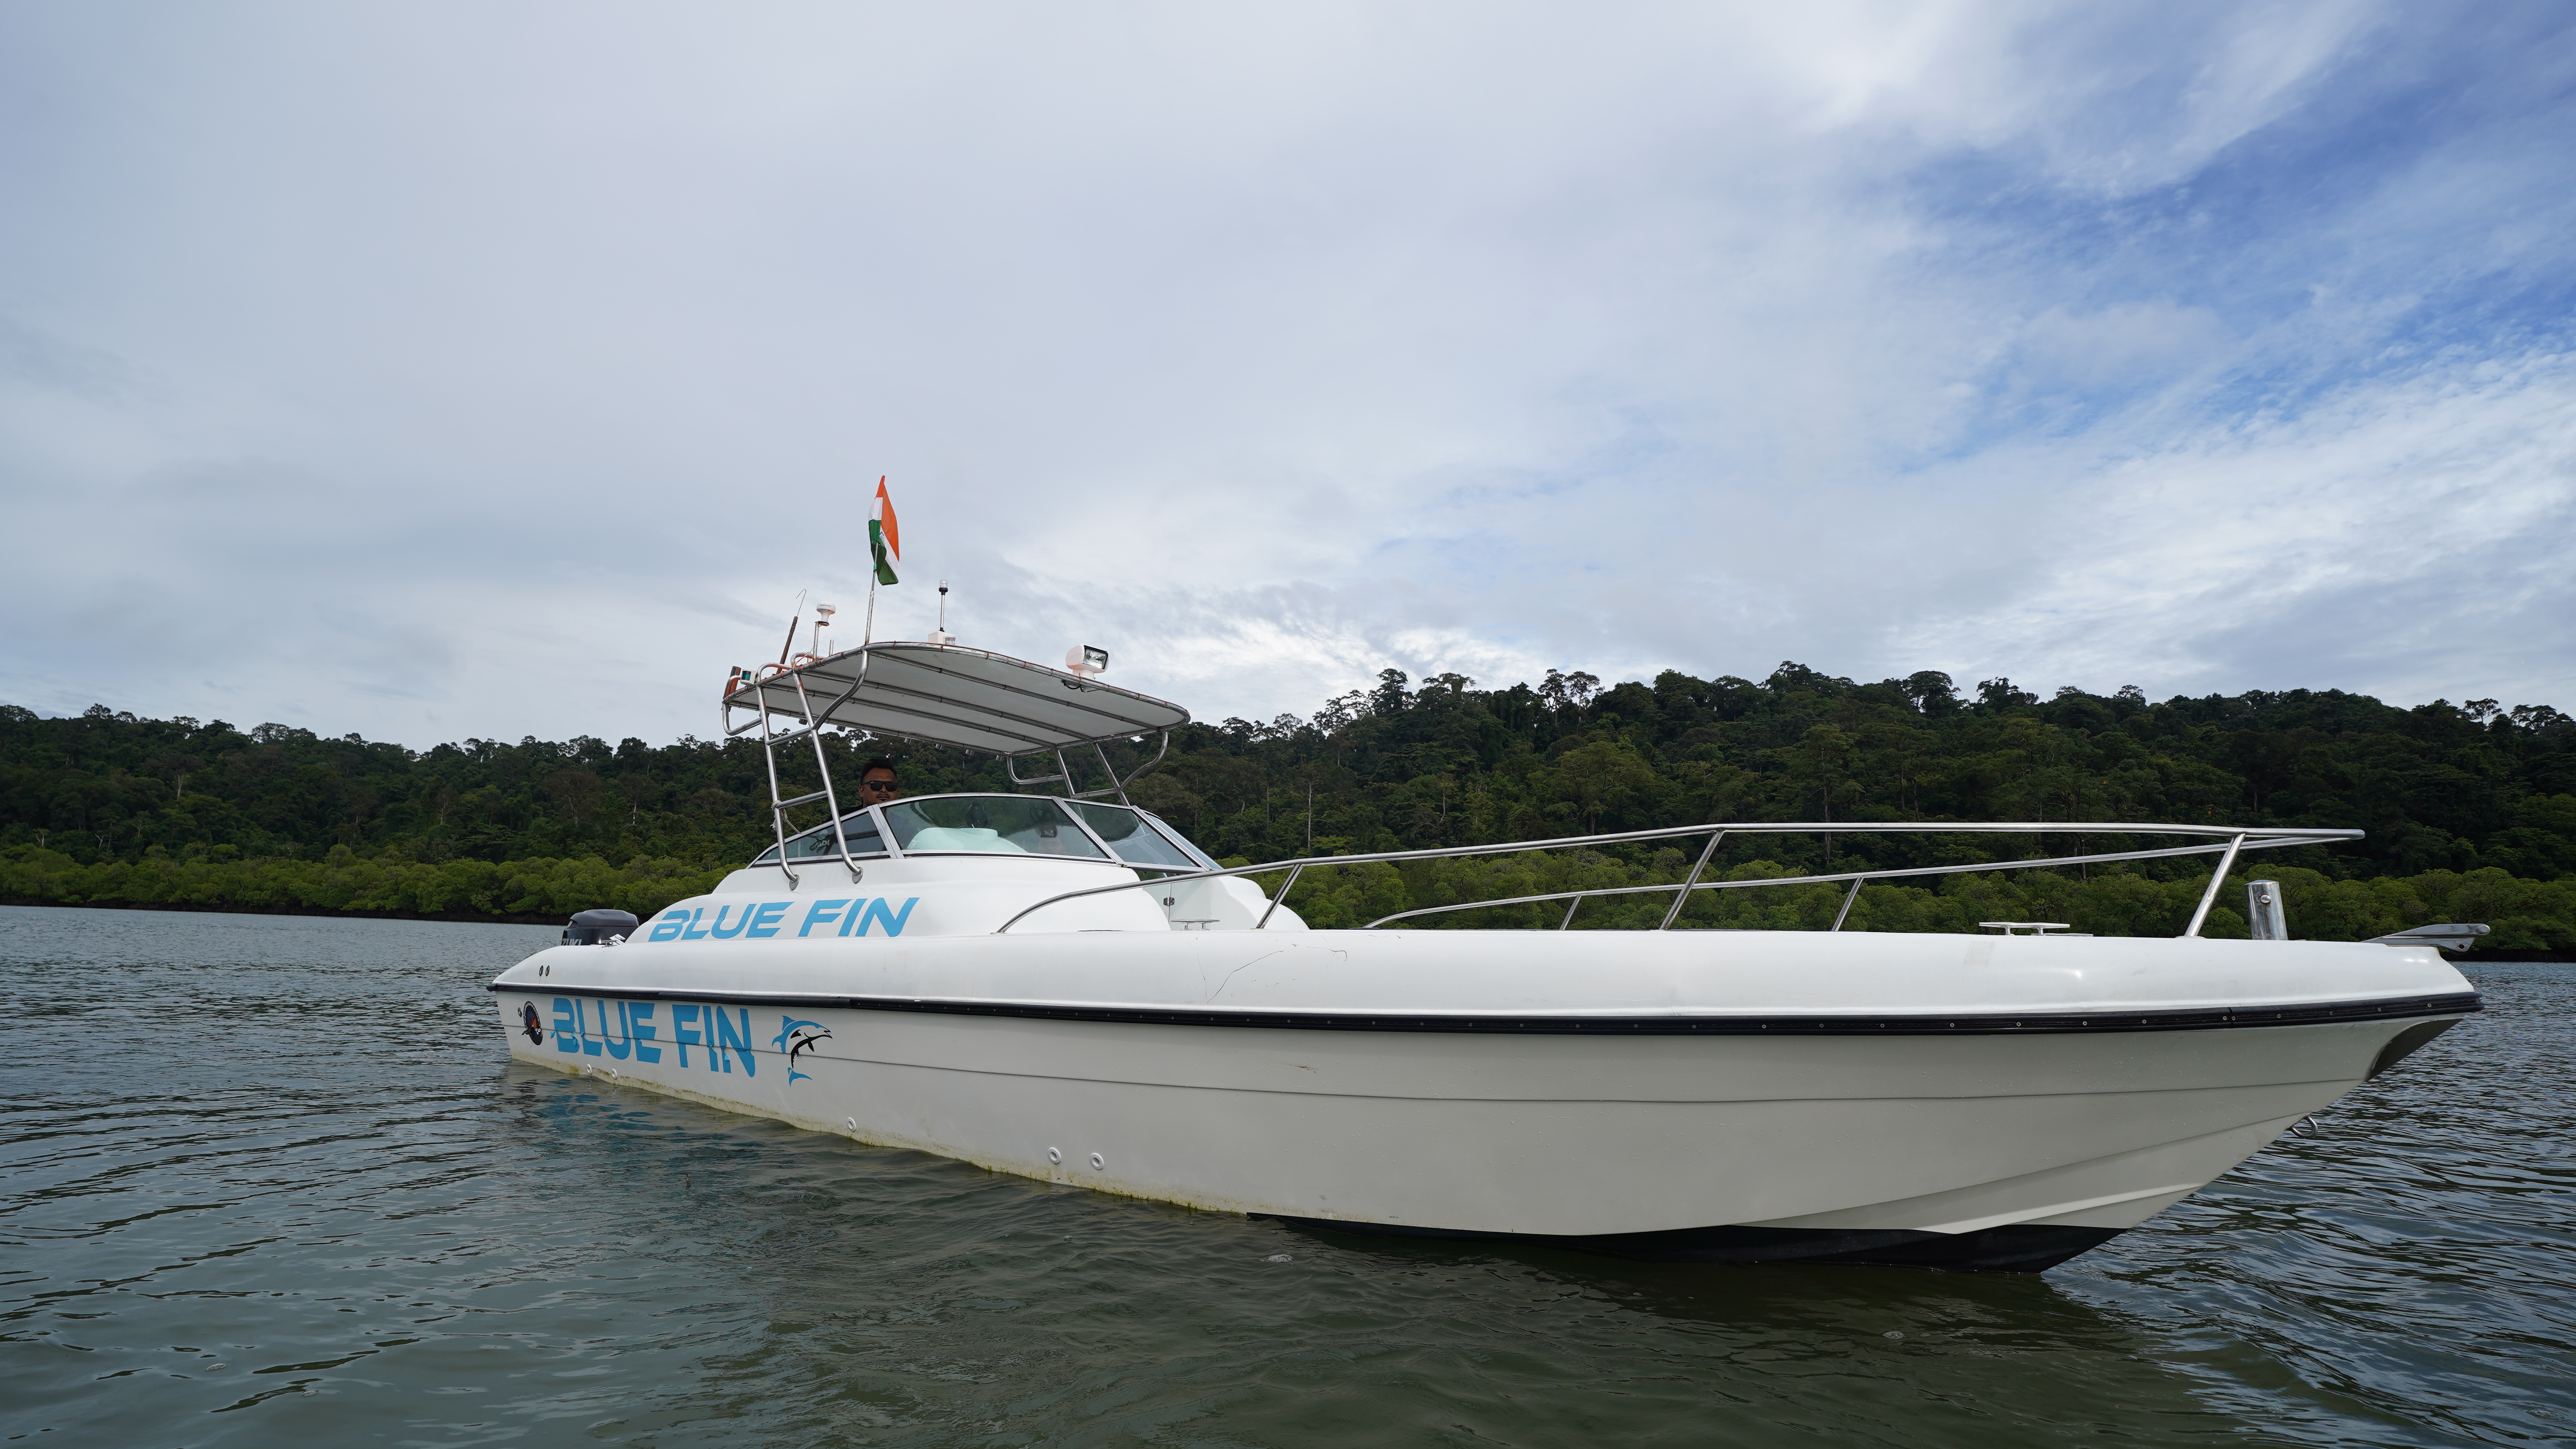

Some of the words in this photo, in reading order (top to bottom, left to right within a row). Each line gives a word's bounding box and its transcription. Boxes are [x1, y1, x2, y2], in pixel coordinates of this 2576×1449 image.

[648, 902, 793, 942] BLUE
[798, 897, 920, 937] FIN
[551, 997, 662, 1064] BLUE
[671, 1004, 756, 1077] FIN
